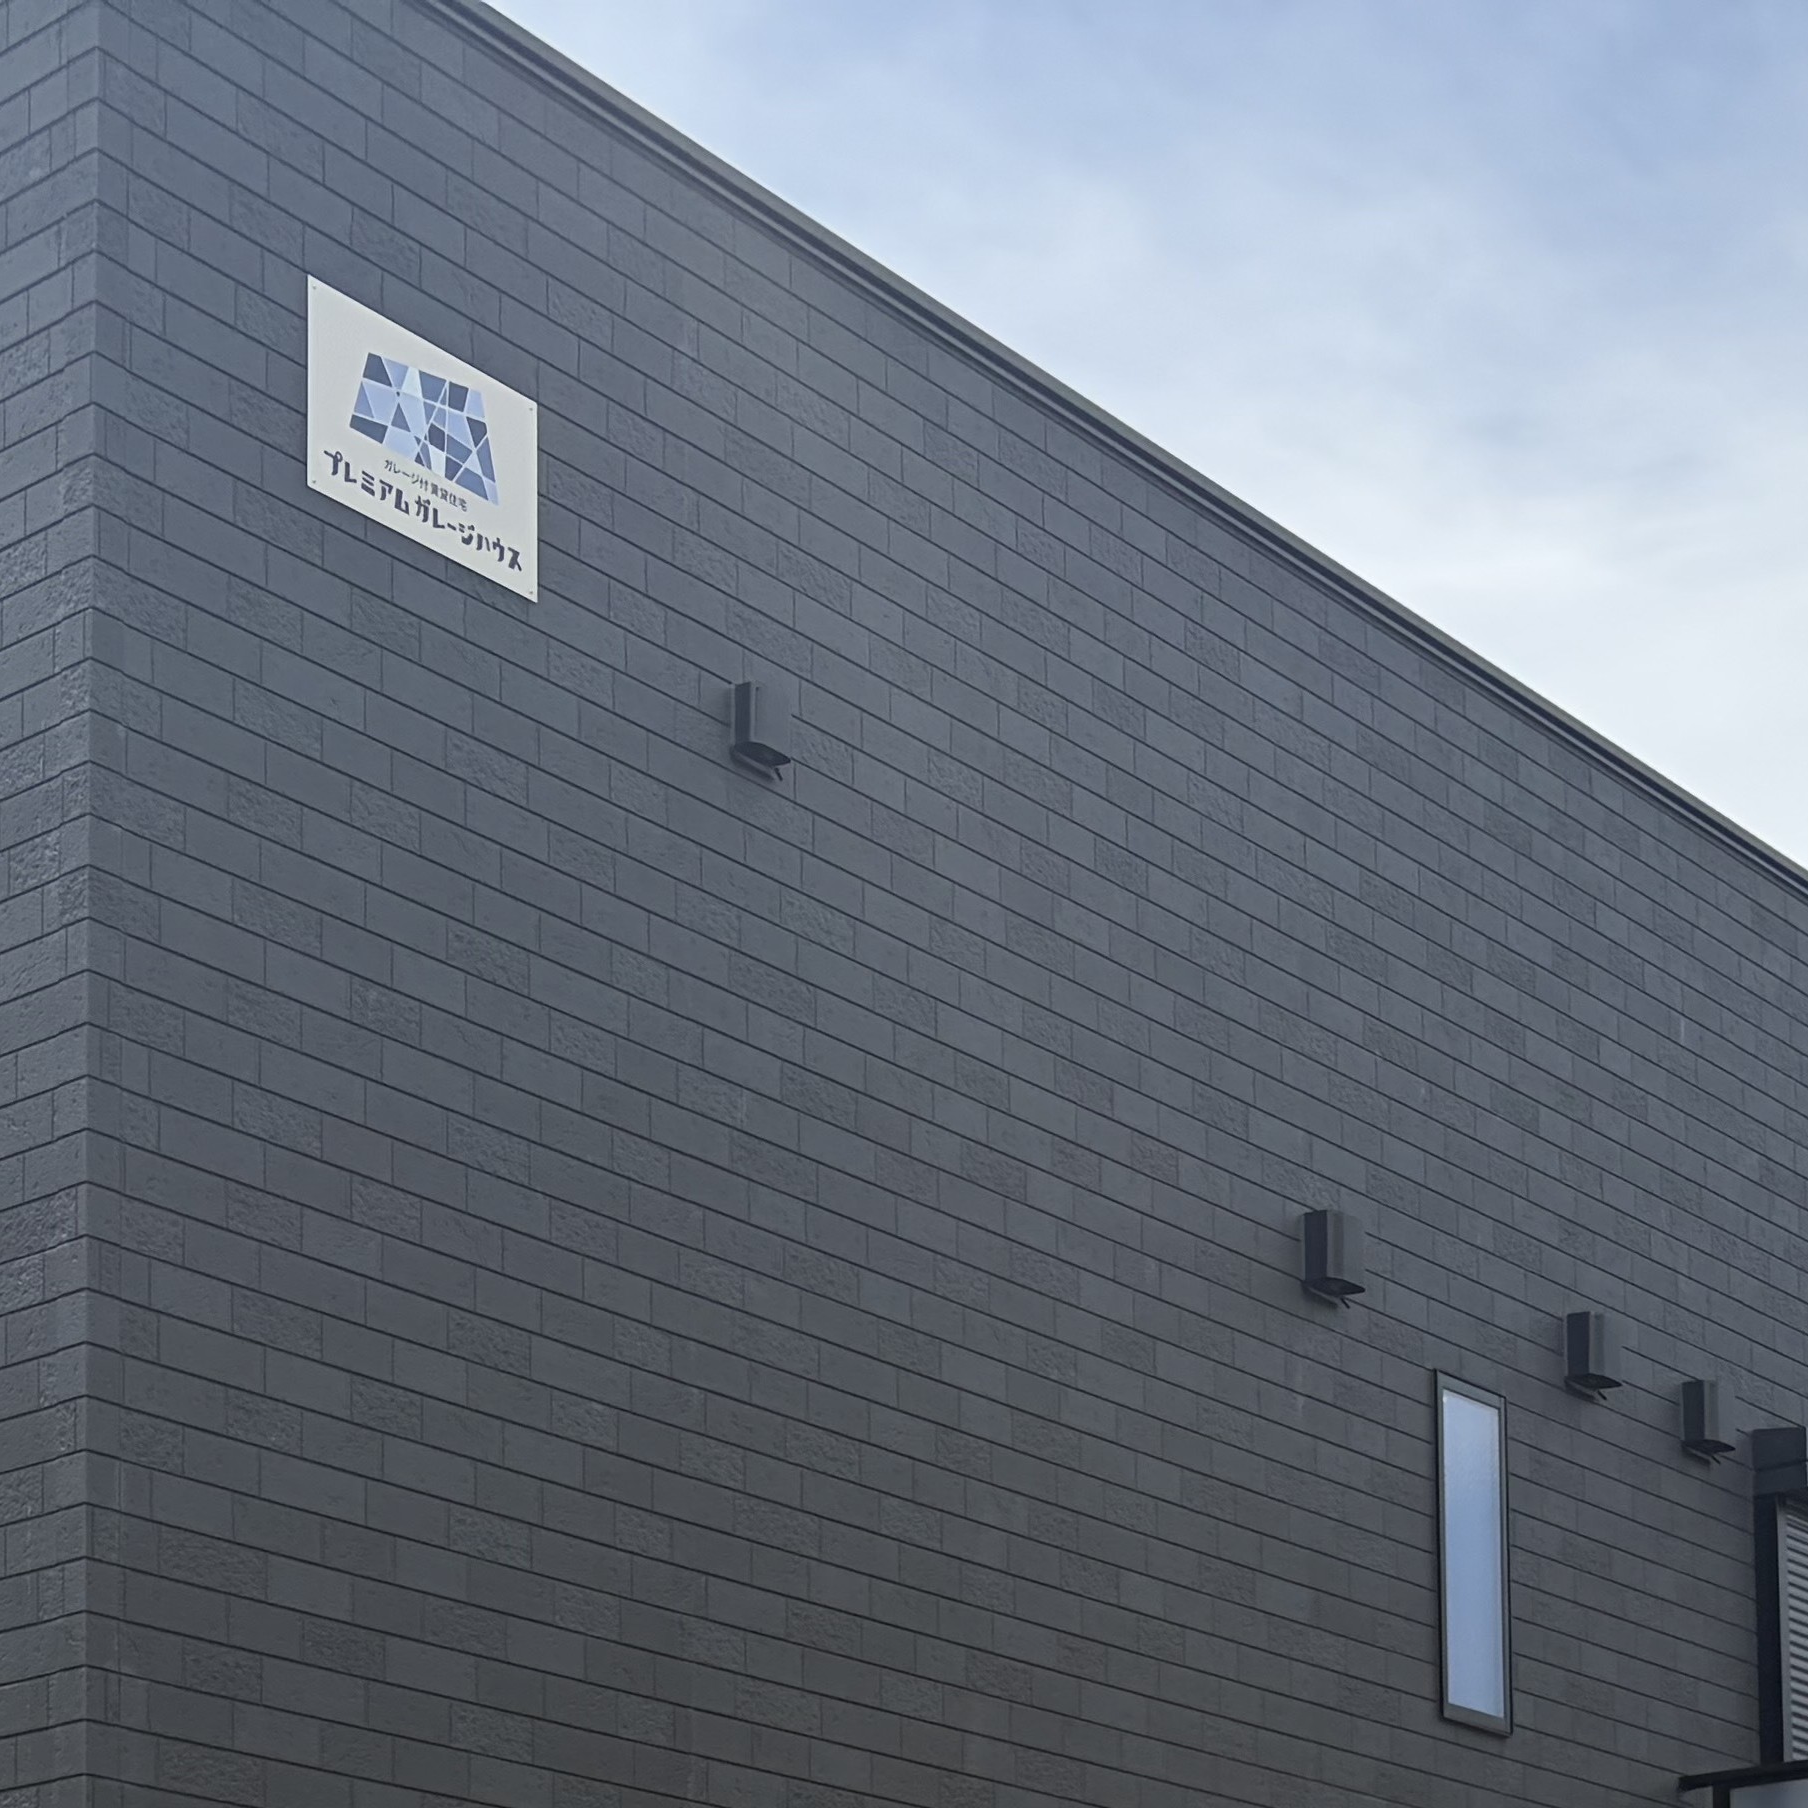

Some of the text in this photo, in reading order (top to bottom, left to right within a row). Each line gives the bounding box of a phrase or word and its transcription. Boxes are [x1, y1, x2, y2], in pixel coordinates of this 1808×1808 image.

[324, 450, 522, 572] プレミアムガレージハウス
